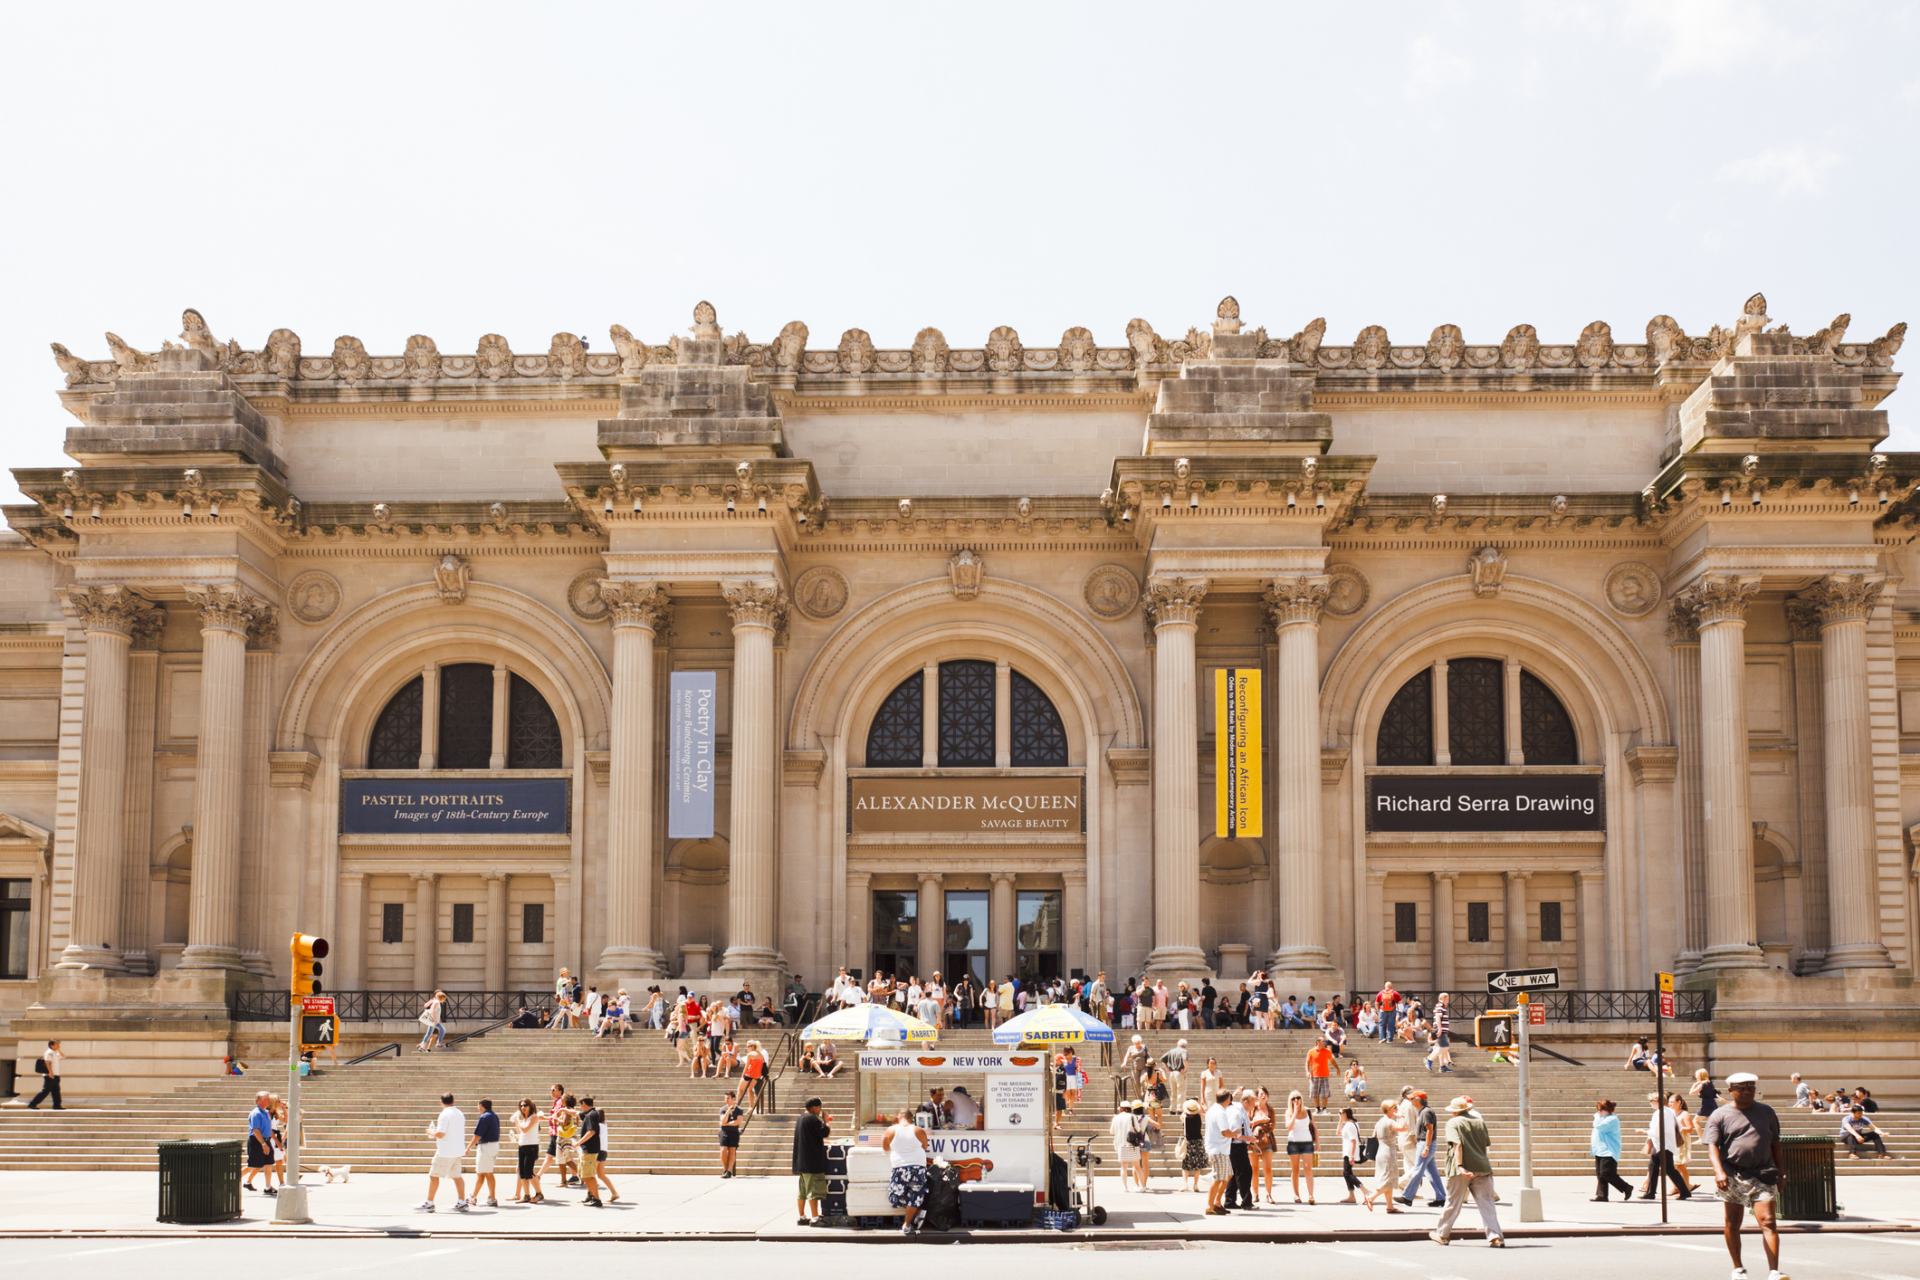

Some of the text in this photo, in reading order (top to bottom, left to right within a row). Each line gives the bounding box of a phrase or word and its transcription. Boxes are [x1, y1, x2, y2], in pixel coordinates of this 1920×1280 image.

[684, 689, 693, 718] Korean
[693, 689, 712, 792] Poetry in Clay
[1237, 677, 1249, 829] Reconfiguring an African Icon
[1227, 769, 1235, 808] Contemporary
[361, 795, 504, 806] PASTEL PORTRAITS
[855, 795, 1078, 813] ALEXANDER McQUEEN
[1377, 795, 1595, 815] Richard Serra Drawing
[394, 809, 549, 822] Images of 18th-Century Europe
[981, 819, 1070, 828] SAVAGE BEAUTY
[1497, 974, 1550, 987] ONE WAY
[911, 1030, 937, 1038] SABRETT
[1025, 1031, 1080, 1040] SABRETT
[861, 1057, 910, 1066] NEW YORK
[953, 1057, 1003, 1066] NEW YORK
[951, 1139, 990, 1153] YORK
